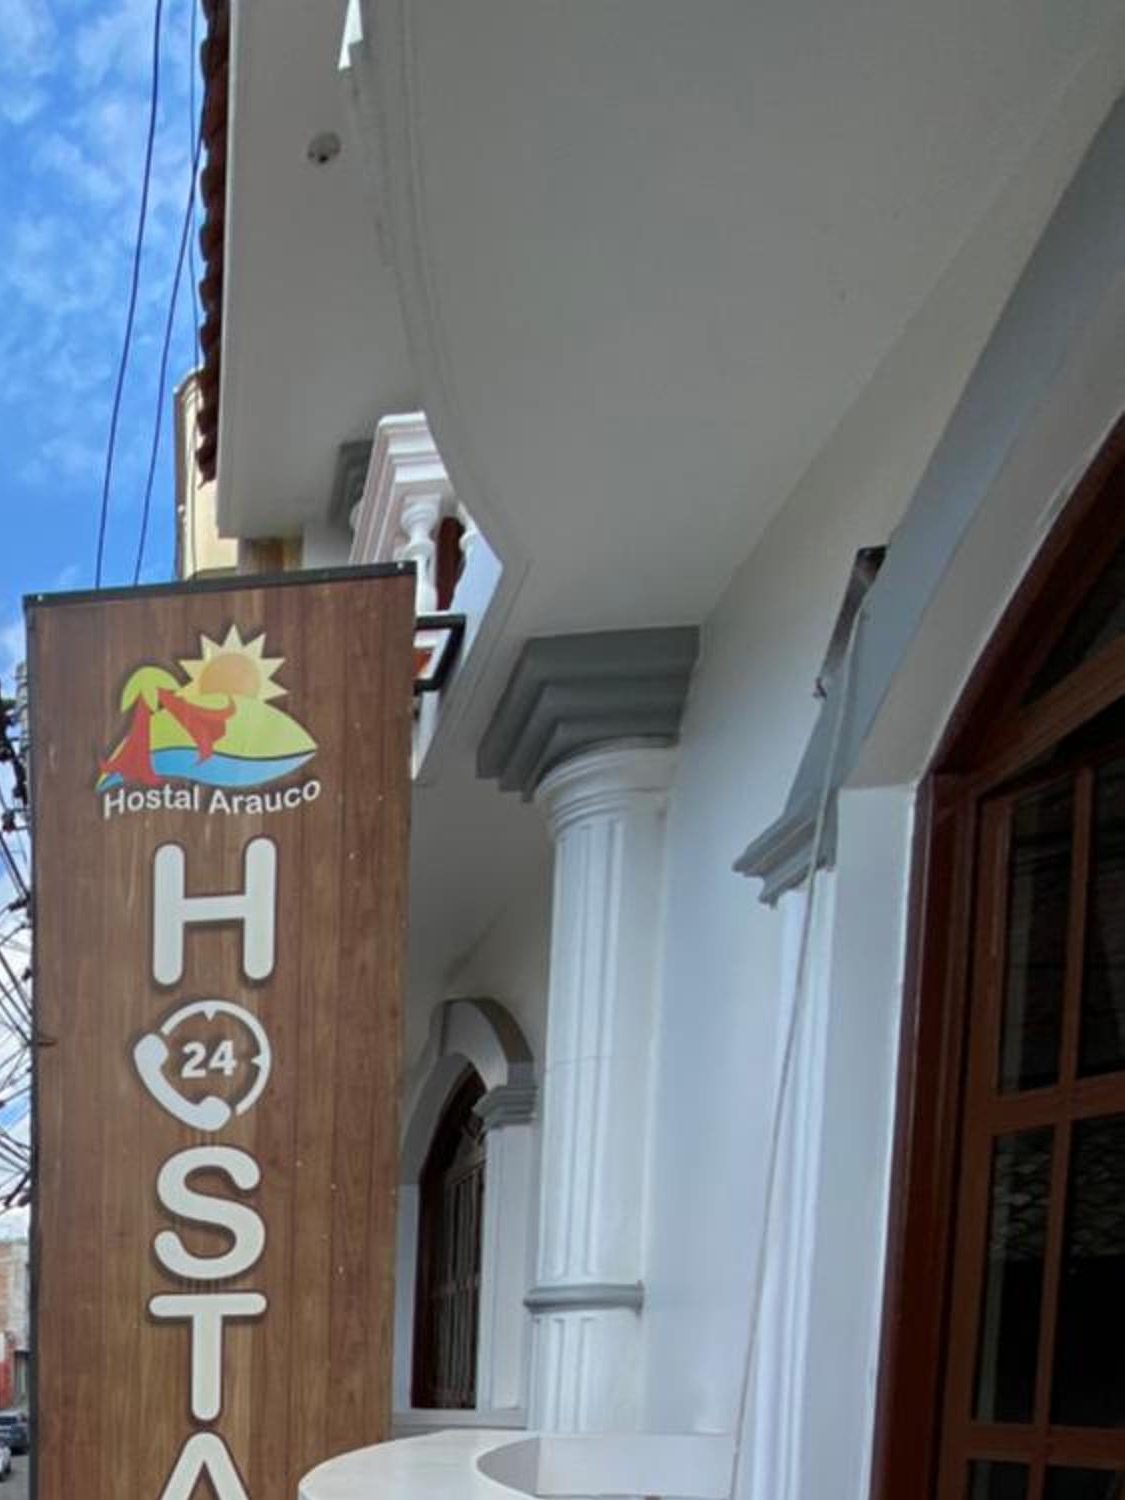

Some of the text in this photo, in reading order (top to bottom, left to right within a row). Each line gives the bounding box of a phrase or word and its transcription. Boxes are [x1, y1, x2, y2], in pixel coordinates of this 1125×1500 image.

[104, 779, 322, 820] Hostal Arauco
[181, 1040, 237, 1079] 24
